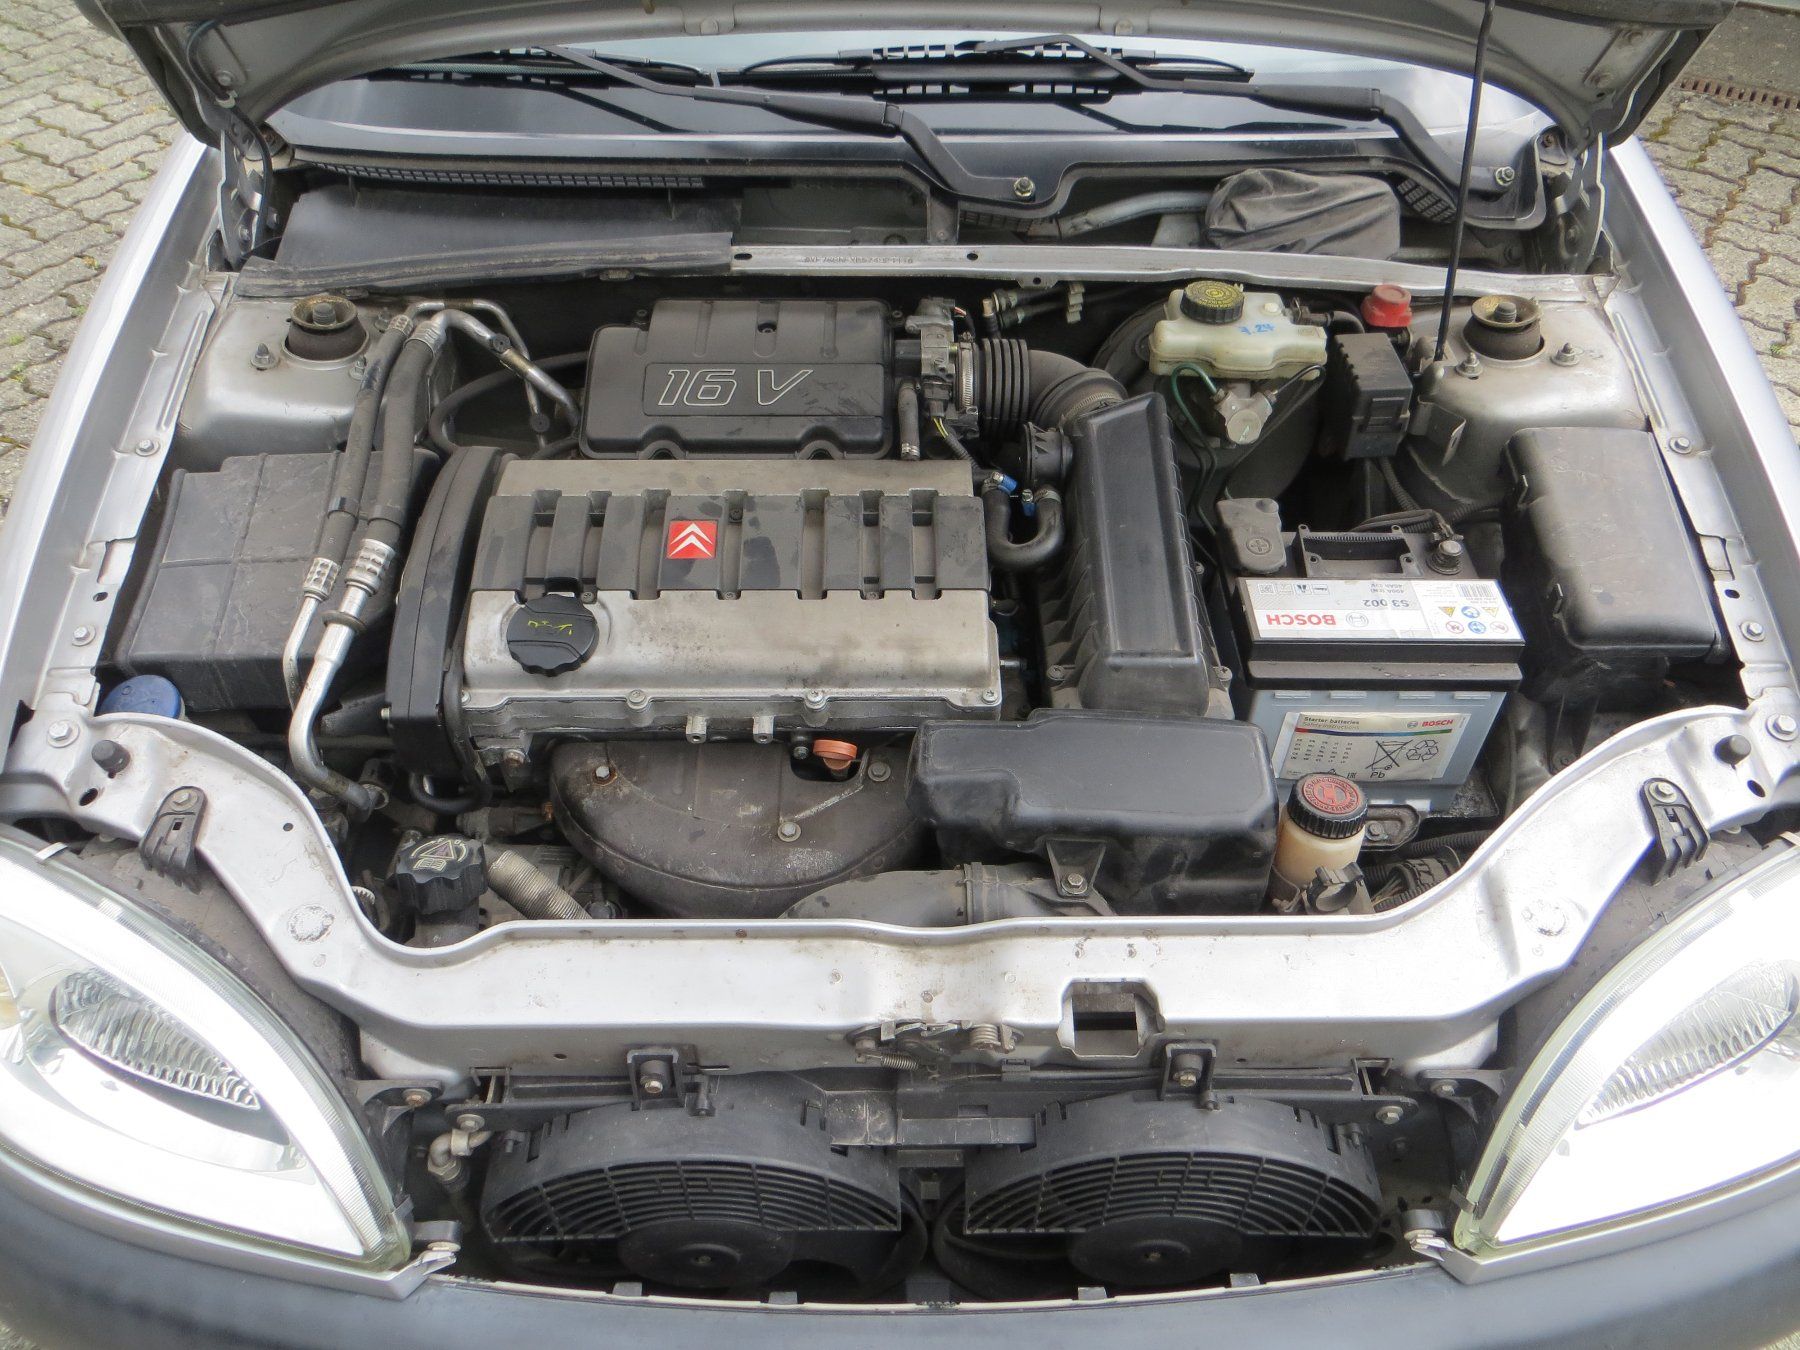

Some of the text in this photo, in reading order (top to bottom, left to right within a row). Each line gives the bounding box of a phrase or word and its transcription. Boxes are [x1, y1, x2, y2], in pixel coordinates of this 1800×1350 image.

[658, 369, 814, 406] 16 V
[1363, 599, 1409, 608] S3 002
[1266, 614, 1337, 626] BOSCH
[1304, 716, 1360, 726] Starter batteries
[1421, 719, 1453, 727] BOSCH
[1370, 771, 1386, 779] Pb
